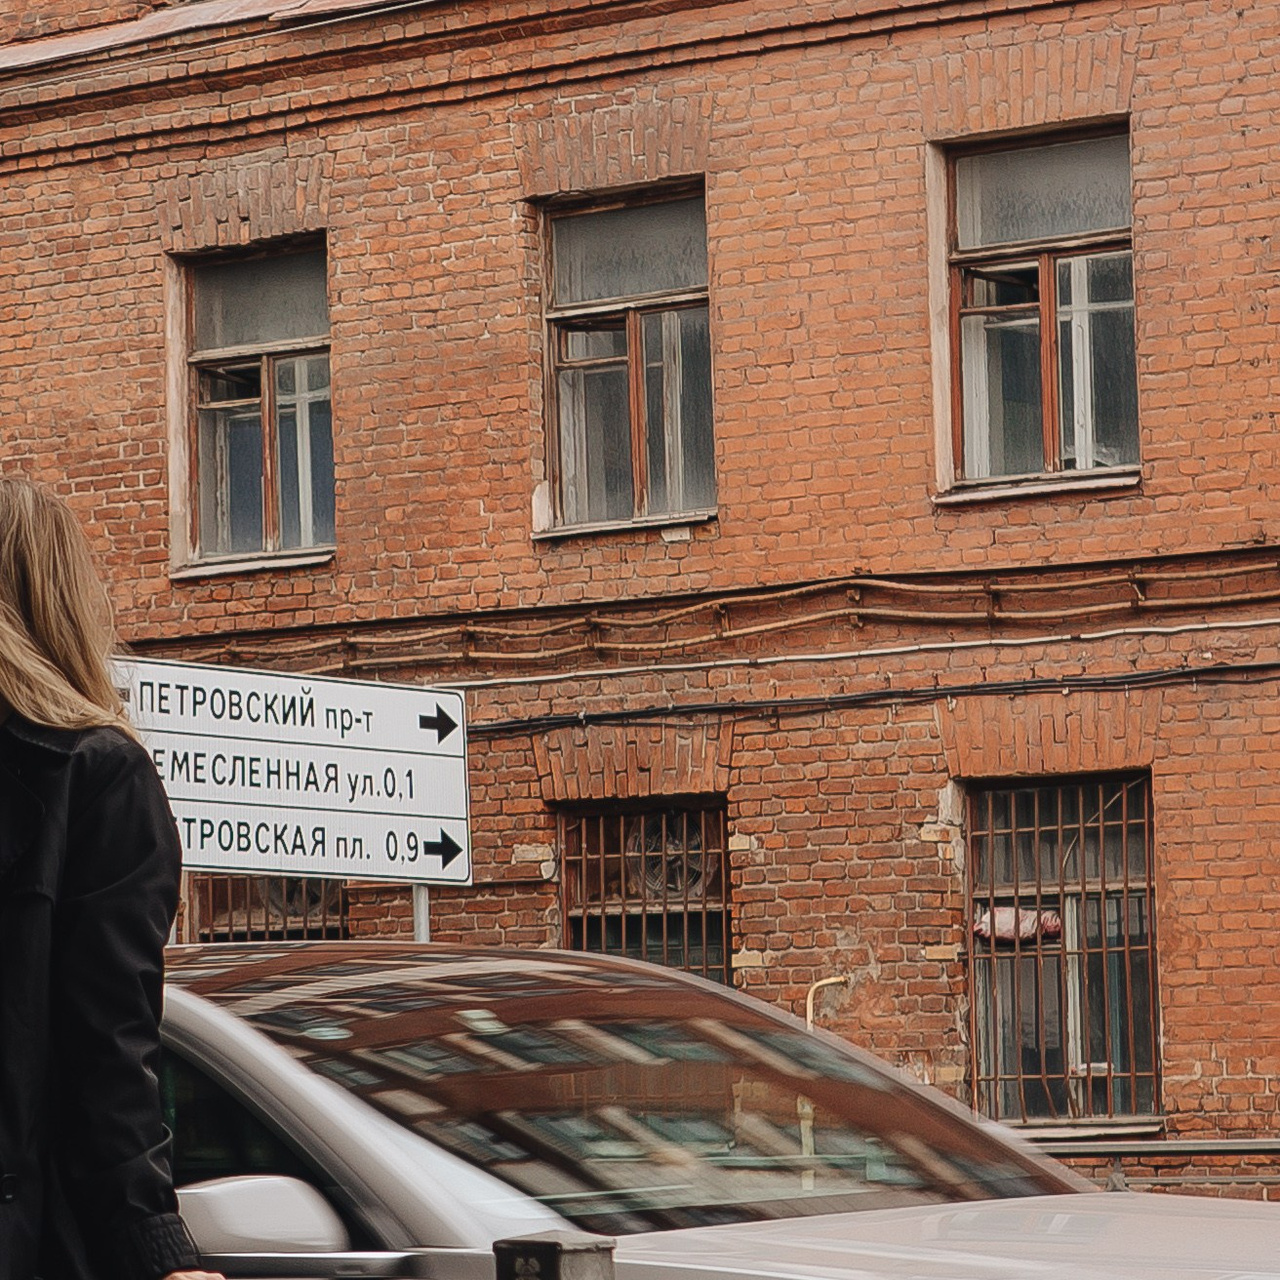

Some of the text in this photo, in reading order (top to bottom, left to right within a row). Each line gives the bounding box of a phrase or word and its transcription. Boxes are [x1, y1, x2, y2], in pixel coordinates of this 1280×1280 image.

[140, 681, 373, 739] ПЕТРОВСКИЙ пр-т
[152, 748, 339, 793] ЕМЕСЛЕННАЯ
[174, 817, 419, 866] ТРОВСКАЯ пл. 0,9
